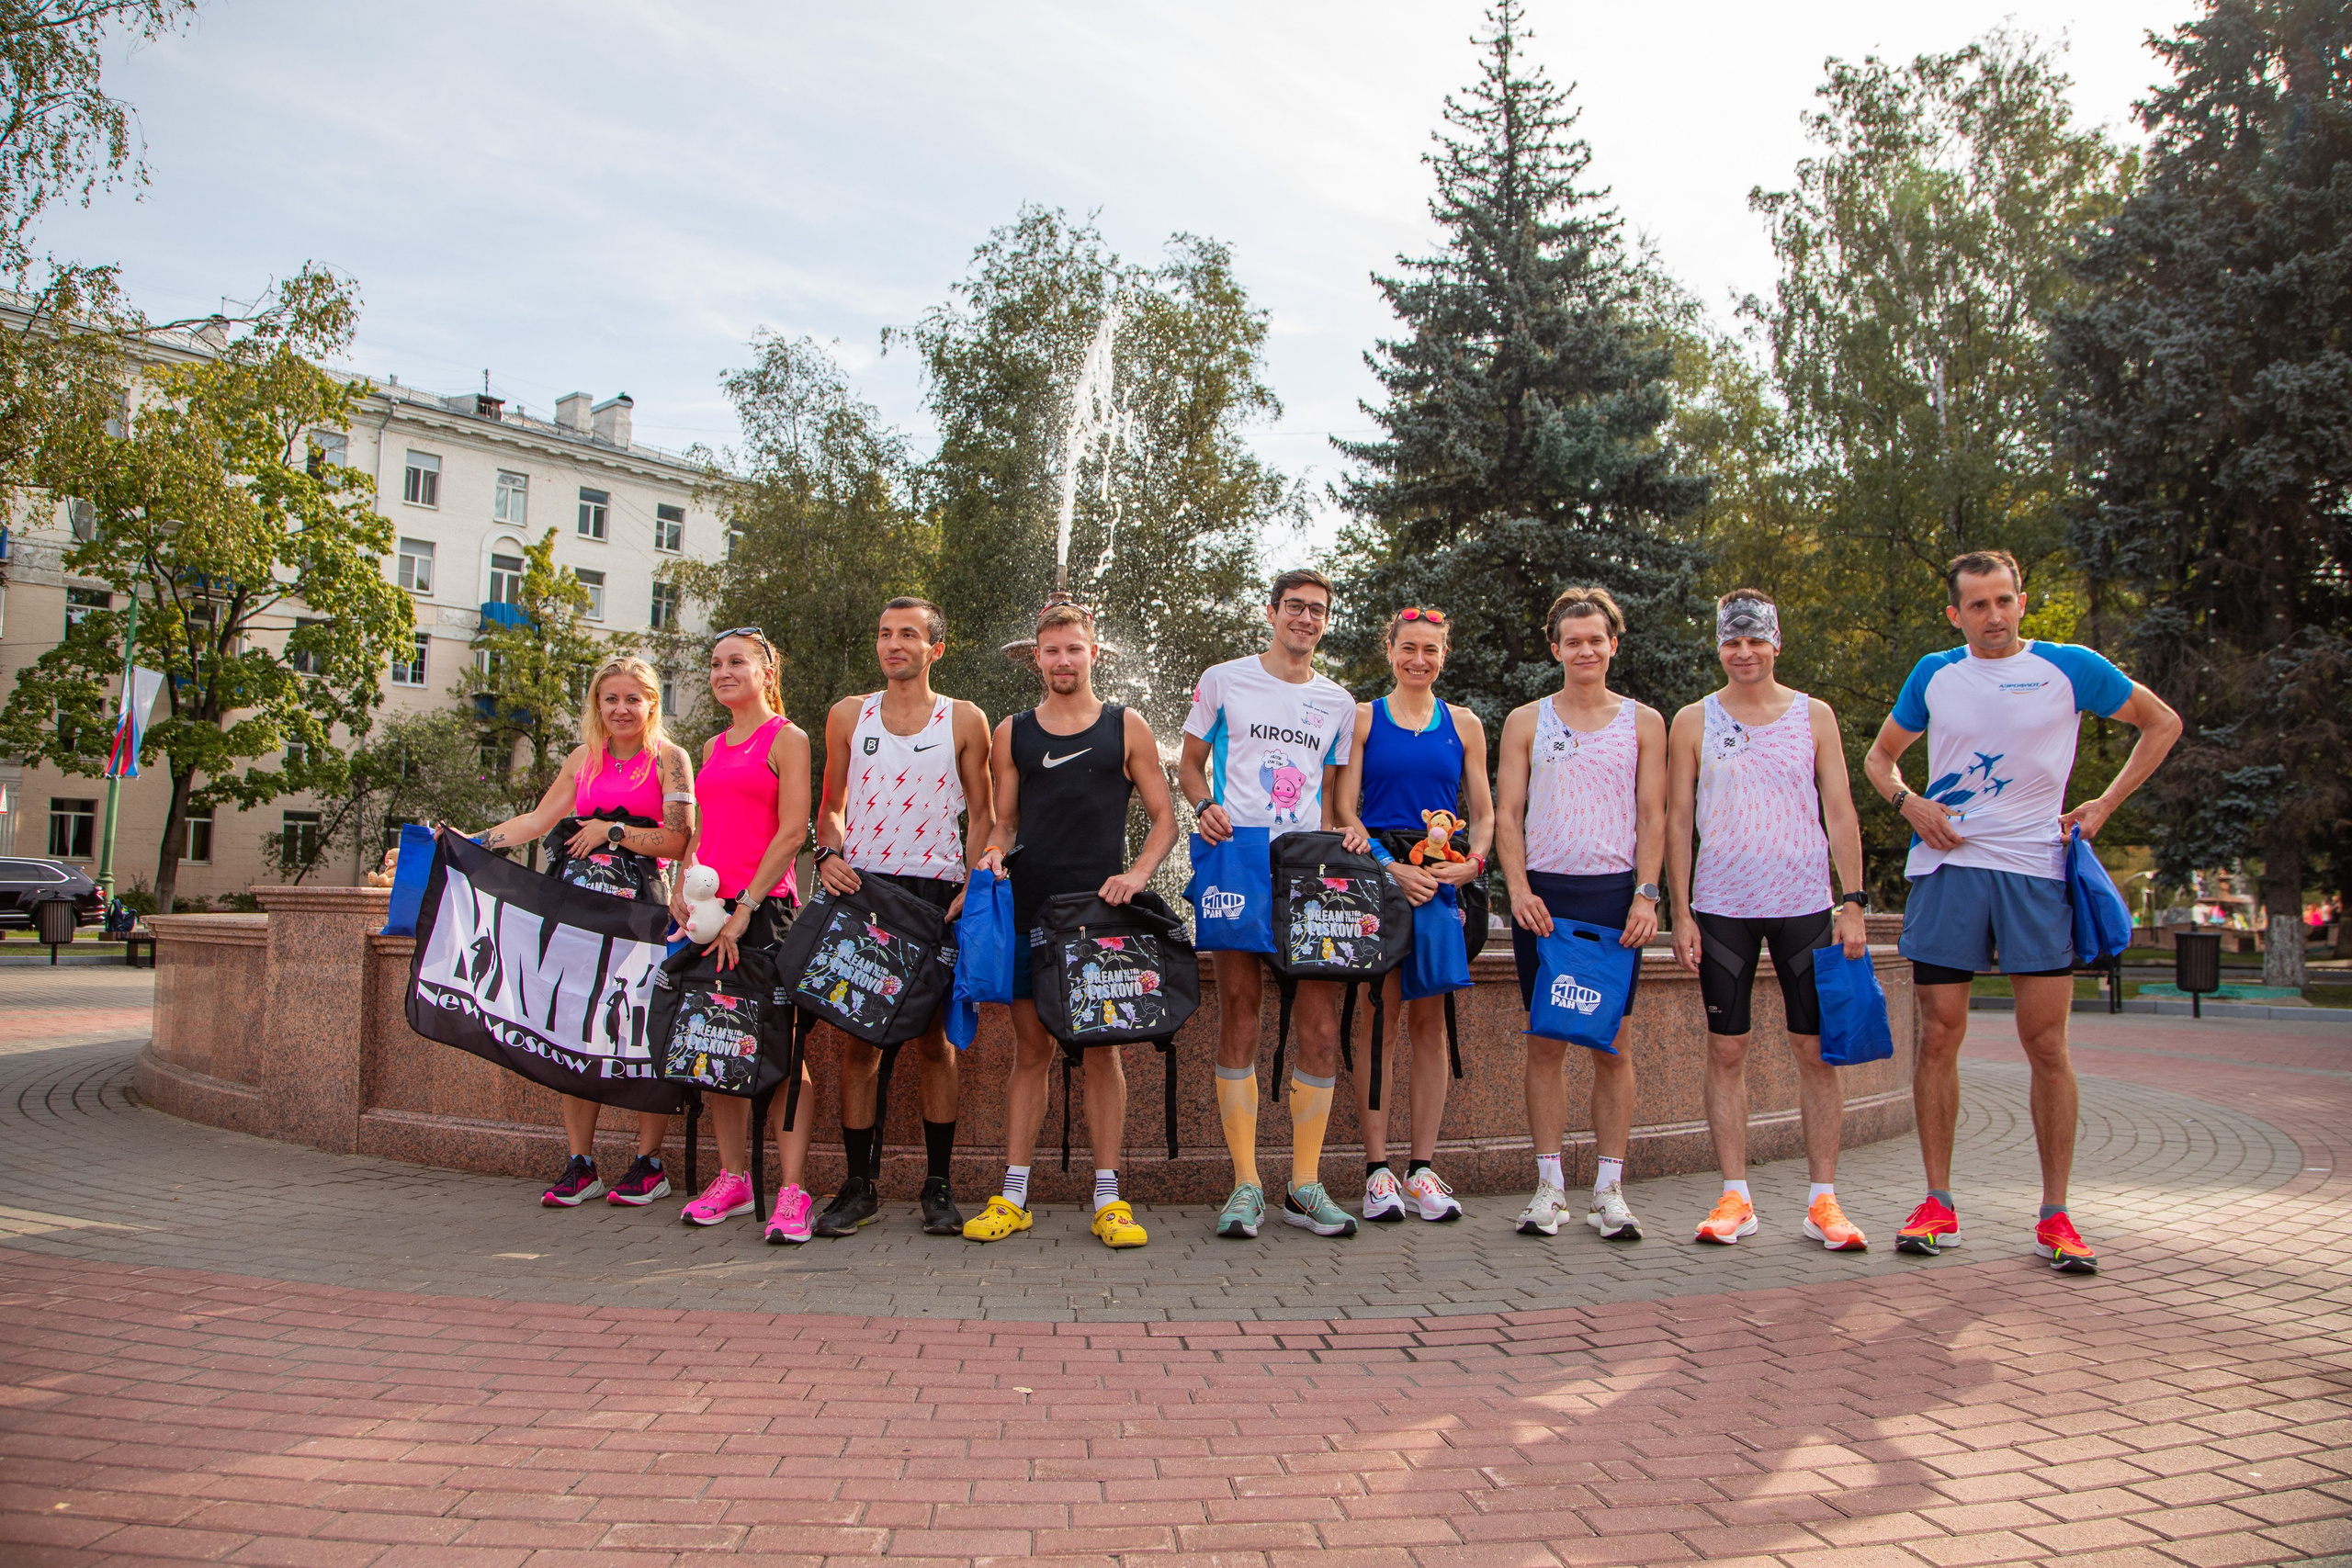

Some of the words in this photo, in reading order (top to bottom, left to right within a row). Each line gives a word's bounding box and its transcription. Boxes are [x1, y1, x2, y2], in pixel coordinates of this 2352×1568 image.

[1250, 723, 1320, 751] KIROSIN
[1203, 908, 1223, 919] РАН
[1306, 909, 1344, 923] DREAM
[1306, 921, 1363, 939] LYSKOVO
[1086, 969, 1124, 985] DREAM
[1086, 981, 1143, 1001] LYSKOVO
[1551, 994, 1576, 1010] РАН
[416, 981, 481, 1020] New
[484, 1014, 592, 1075] Moscow
[689, 1022, 728, 1039] DREAM
[687, 1033, 741, 1057] LYSKOVO
